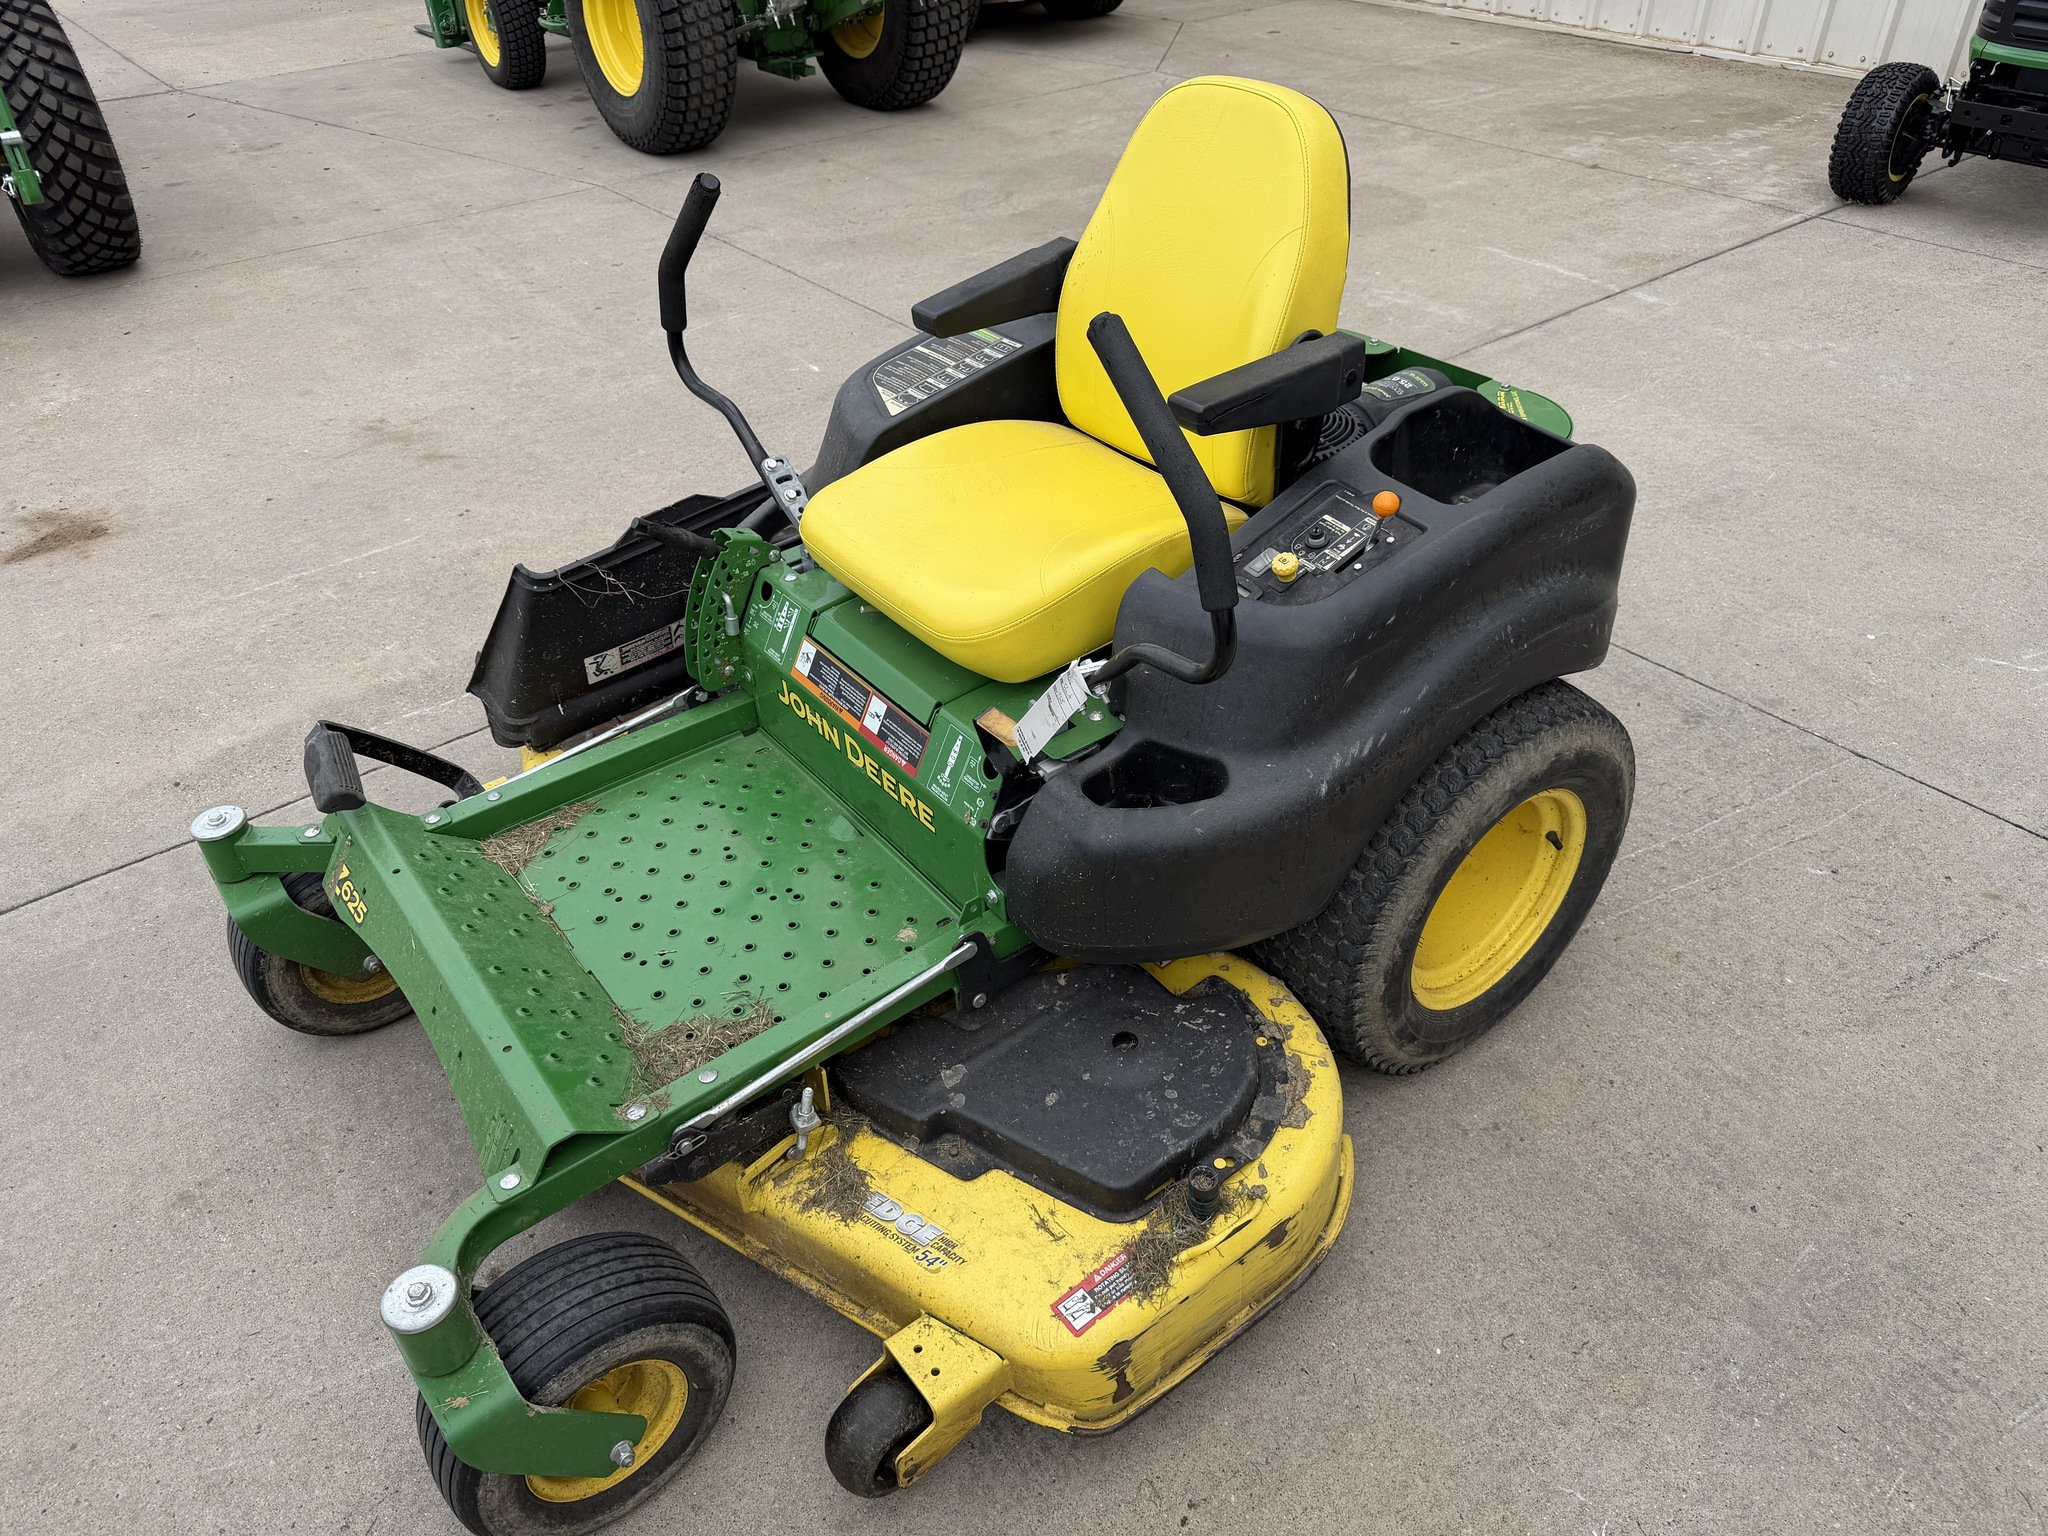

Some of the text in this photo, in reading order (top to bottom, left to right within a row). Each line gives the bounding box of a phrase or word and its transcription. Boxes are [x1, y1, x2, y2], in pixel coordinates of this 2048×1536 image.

[777, 679, 841, 751] JOHN
[843, 731, 936, 833] DEERE
[881, 744, 903, 763] DANGER
[861, 1190, 945, 1247] EDGE
[860, 1214, 920, 1254] CUTTING SYSTEM
[938, 1236, 959, 1250] HIGH
[915, 1249, 949, 1267] 54"
[930, 1241, 968, 1266] CAPACITY
[1099, 1253, 1127, 1276] DANGER
[1093, 1272, 1120, 1293] ROTATING
